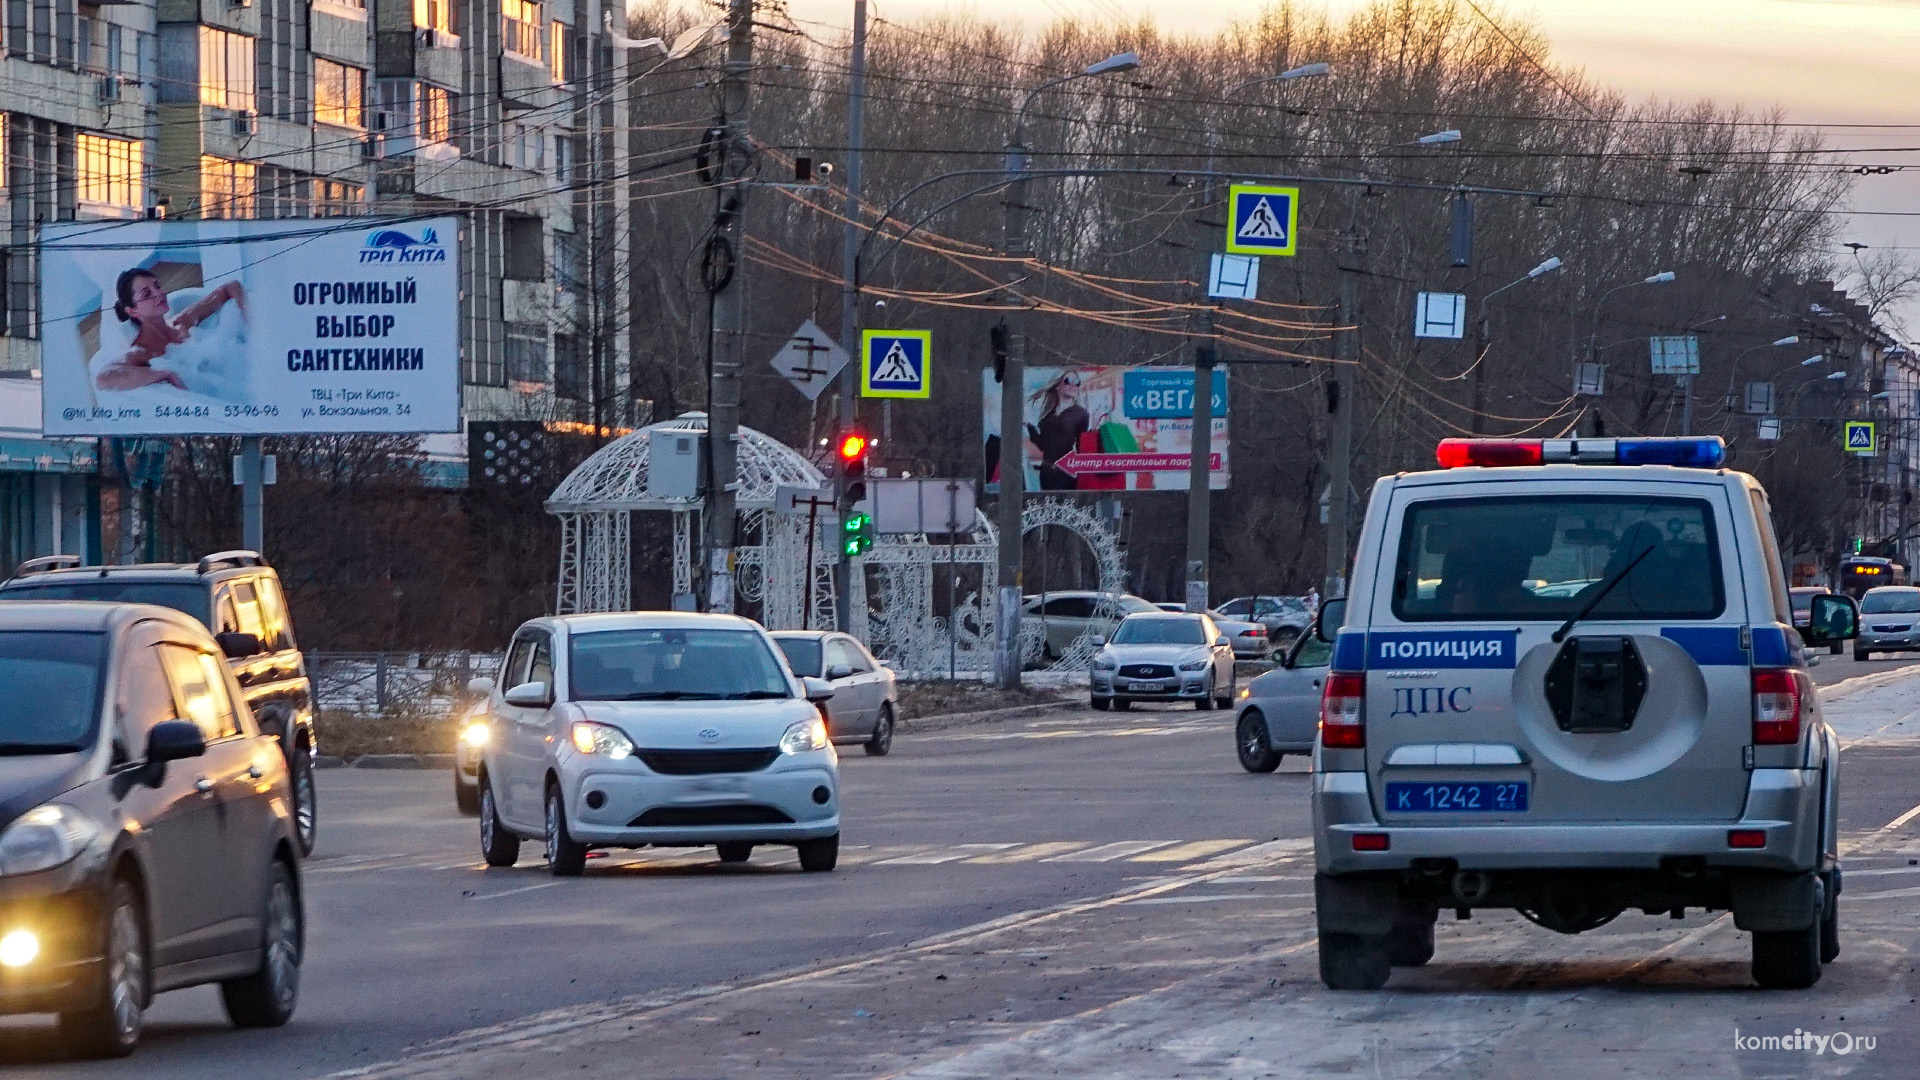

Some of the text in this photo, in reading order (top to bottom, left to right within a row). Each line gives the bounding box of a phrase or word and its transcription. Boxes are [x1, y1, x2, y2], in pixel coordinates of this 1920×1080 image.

[359, 246, 446, 263] ТРИ КИТА
[294, 276, 416, 305] ОГРОМНЫЙ
[316, 315, 395, 338] ВЫБОР
[288, 348, 424, 372] САНТЕХНИКИ
[311, 388, 401, 403] ТВЦ «Три Кита»
[155, 405, 209, 418] 54-84-84
[224, 404, 279, 417] 53-96-96
[320, 405, 392, 417] Вокзальная,
[396, 404, 412, 416] 34
[1067, 457, 1102, 468] Центр
[1105, 458, 1167, 467] счастливых
[1380, 640, 1502, 660] ПОЛИЦИЯ
[1390, 686, 1472, 718] ДПС
[1423, 786, 1481, 808] 1242
[1497, 785, 1518, 801] 27
